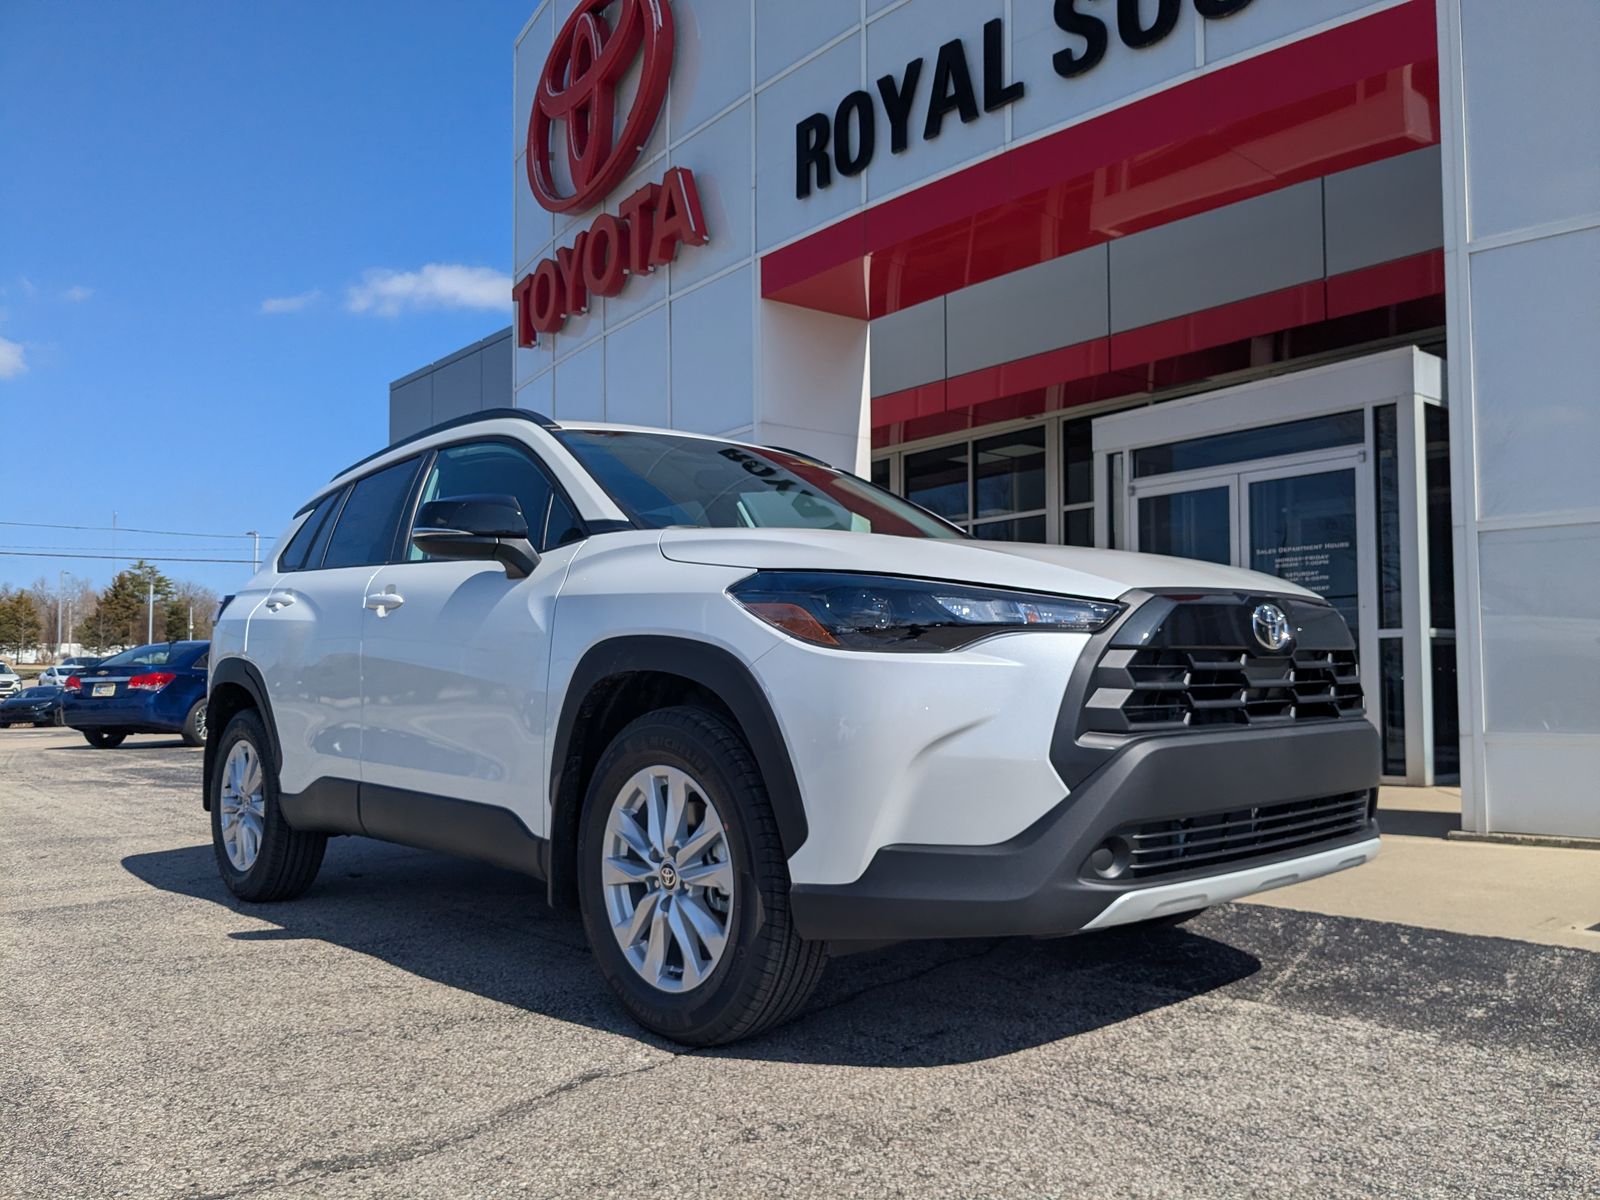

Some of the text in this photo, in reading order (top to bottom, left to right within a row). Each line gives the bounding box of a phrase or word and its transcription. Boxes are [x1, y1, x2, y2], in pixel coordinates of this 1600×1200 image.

[795, 18, 1025, 200] ROYAL
[512, 165, 709, 349] TOYOTA
[1278, 543, 1323, 553] DEPARTMENT
